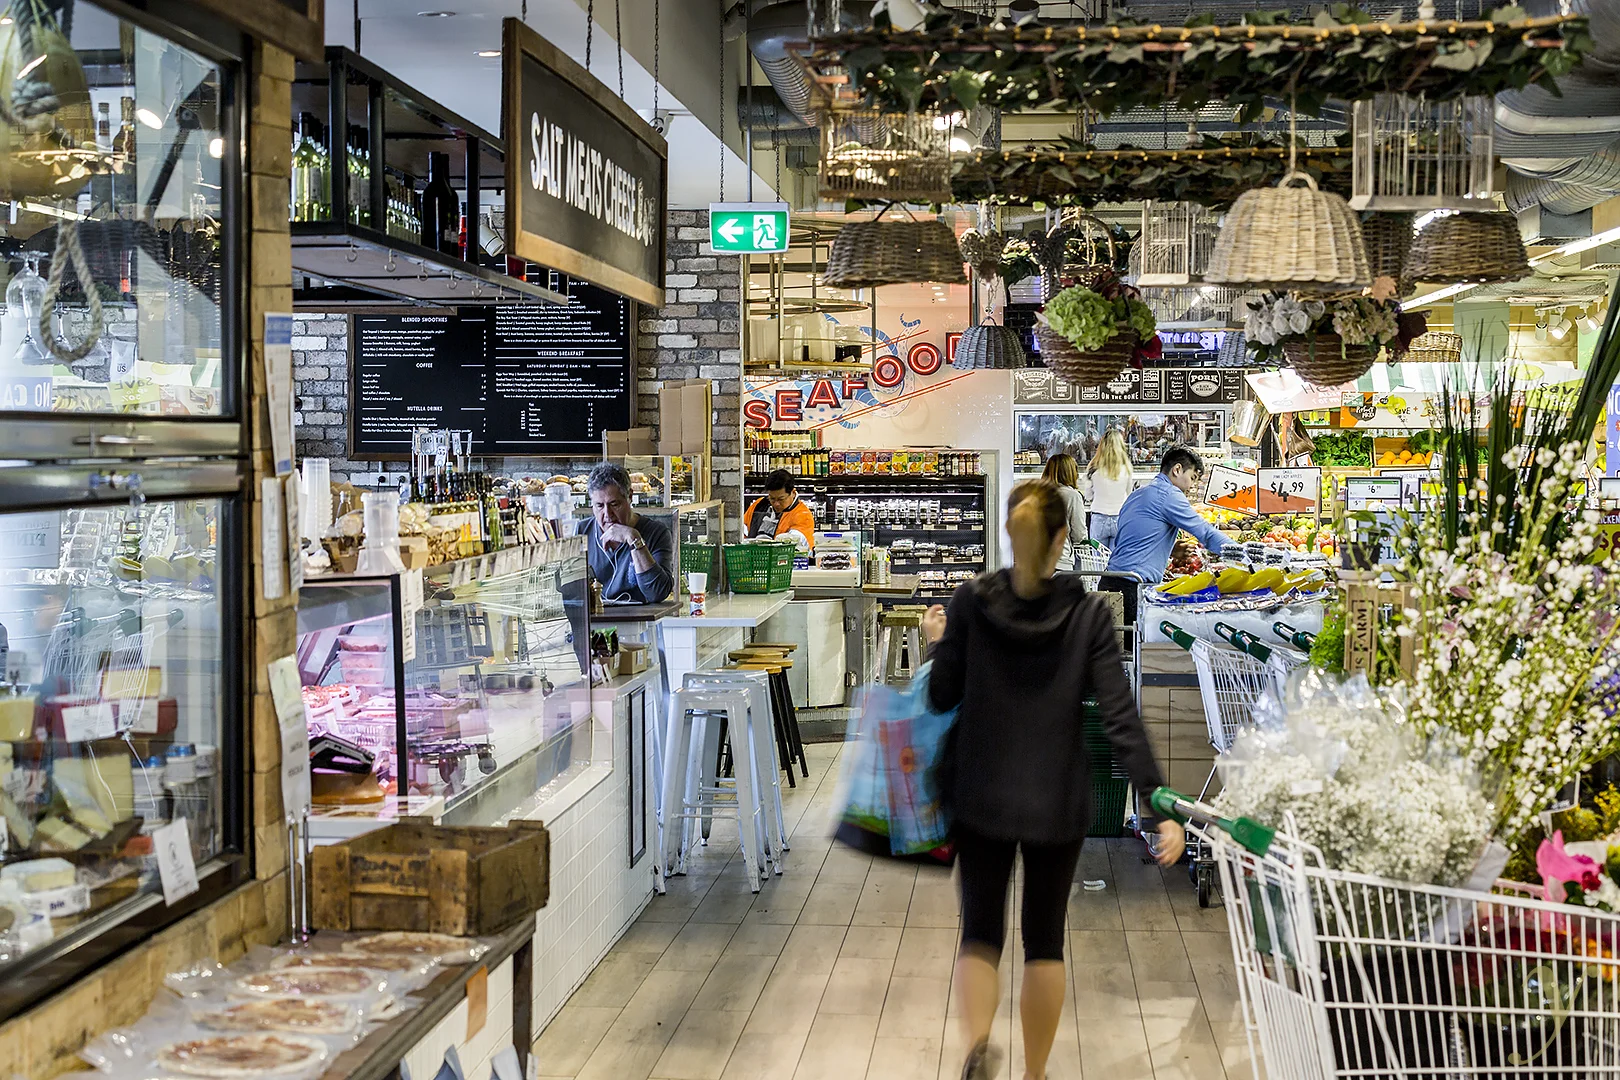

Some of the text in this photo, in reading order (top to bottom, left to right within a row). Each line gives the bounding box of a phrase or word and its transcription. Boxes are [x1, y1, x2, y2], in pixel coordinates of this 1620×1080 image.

[530, 111, 637, 241] SALT MEATS CHEESE
[1190, 374, 1218, 383] PORK
[1270, 481, 1304, 502] $4.99
